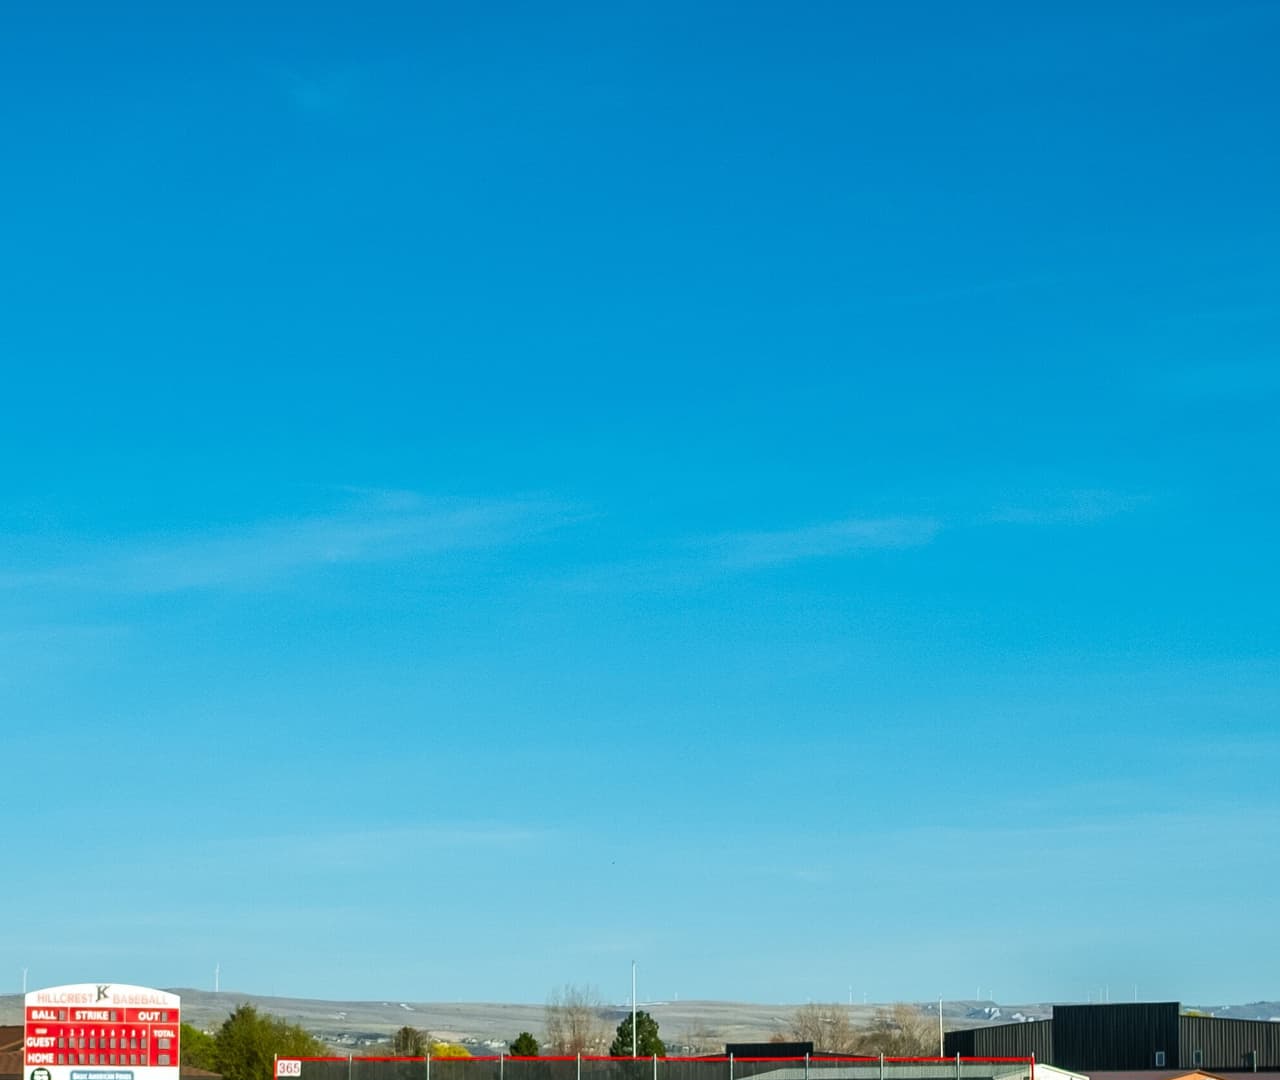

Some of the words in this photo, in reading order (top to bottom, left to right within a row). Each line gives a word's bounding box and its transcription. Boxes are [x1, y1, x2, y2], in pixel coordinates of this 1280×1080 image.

[112, 994, 168, 1005] BASEBALL
[31, 1011, 56, 1020] BALL
[75, 1011, 109, 1020] STRIKE
[138, 1011, 160, 1021] OUT
[153, 1030, 175, 1038] TOTAL
[26, 1037, 56, 1047] GUEST
[27, 1053, 54, 1063] HOME
[279, 1062, 300, 1073] 365
